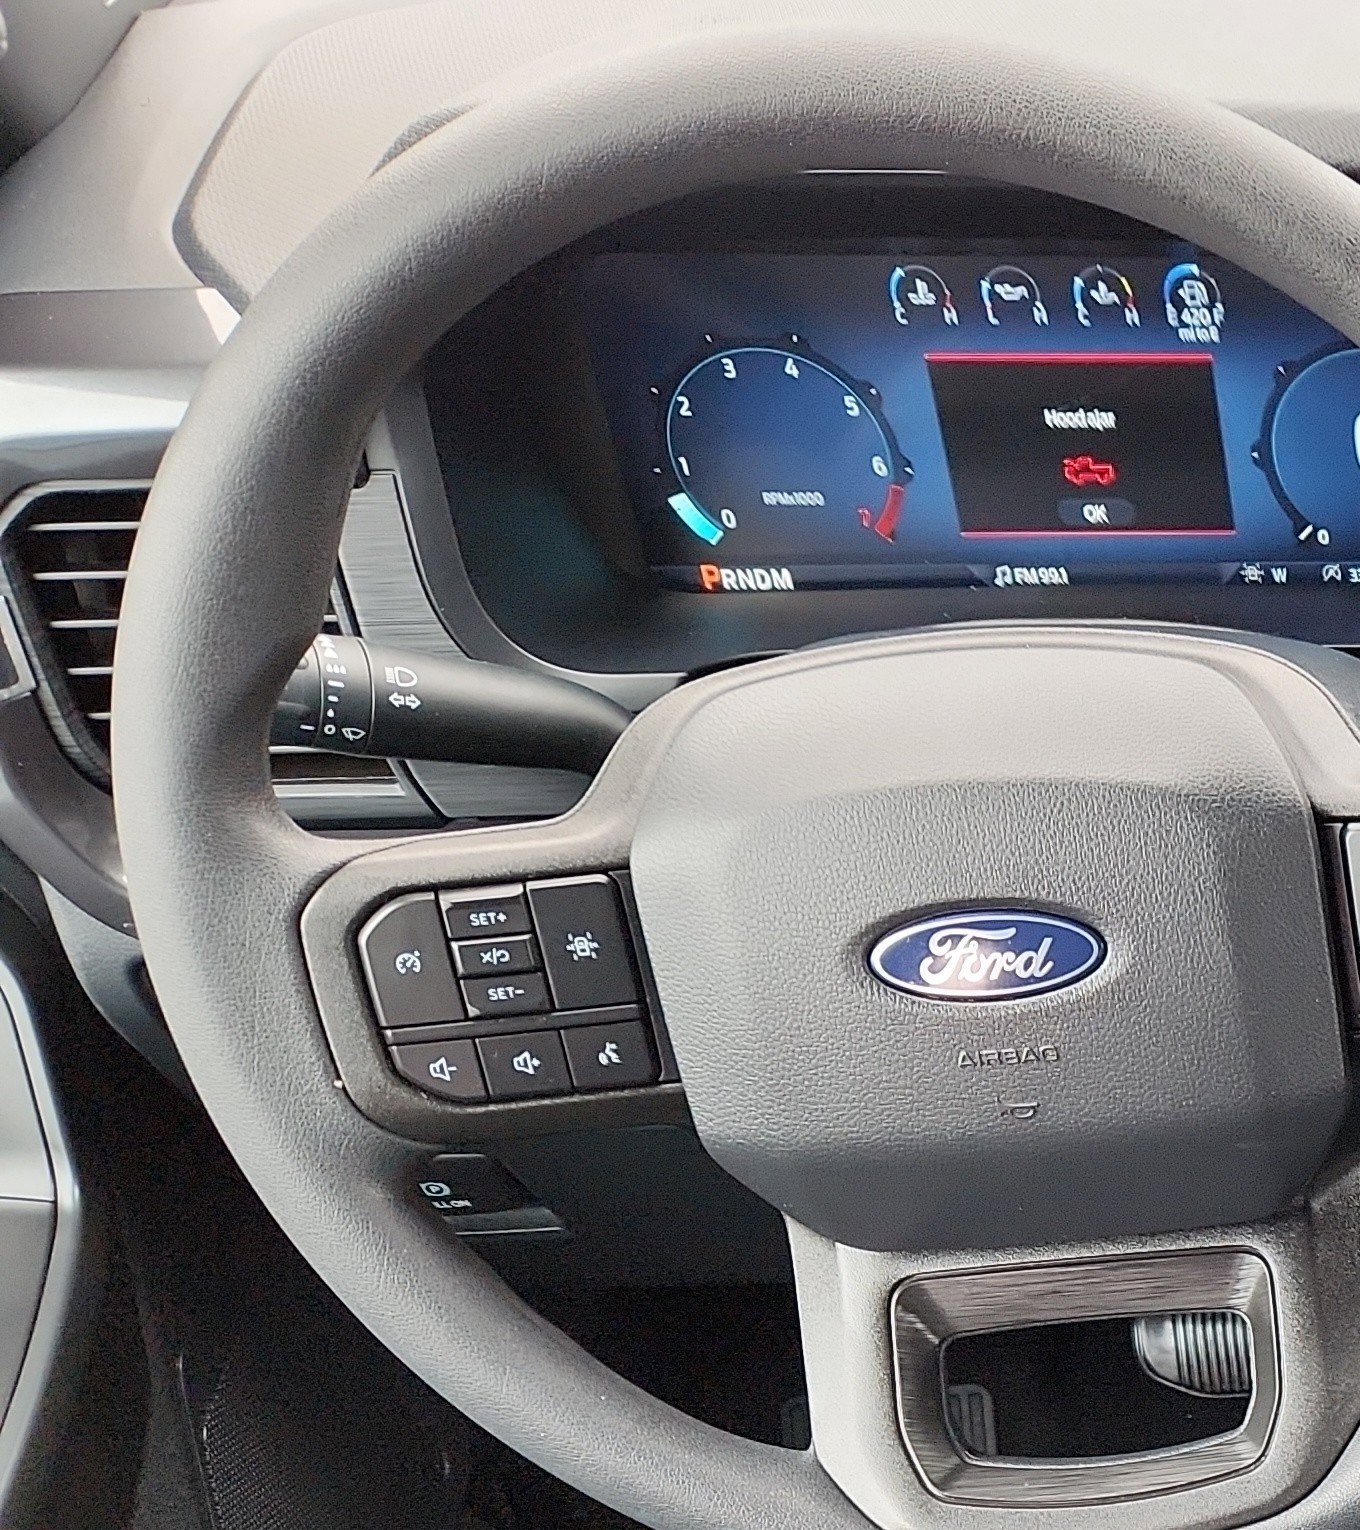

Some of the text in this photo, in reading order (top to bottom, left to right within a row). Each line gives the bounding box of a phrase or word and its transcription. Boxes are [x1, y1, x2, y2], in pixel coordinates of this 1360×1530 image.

[720, 358, 737, 379] 3
[784, 358, 800, 379] 4
[676, 396, 692, 417] 2
[843, 395, 860, 417] 5
[1043, 408, 1088, 429] Hood
[677, 456, 690, 477] 1
[871, 455, 888, 477] 6
[720, 508, 737, 529] 0
[1083, 504, 1111, 525] OK
[1316, 529, 1330, 546] 0
[1013, 566, 1036, 586] FM
[1270, 567, 1288, 583] W
[919, 926, 1055, 985] Ford
[957, 1045, 1060, 1069] AIRBAG
